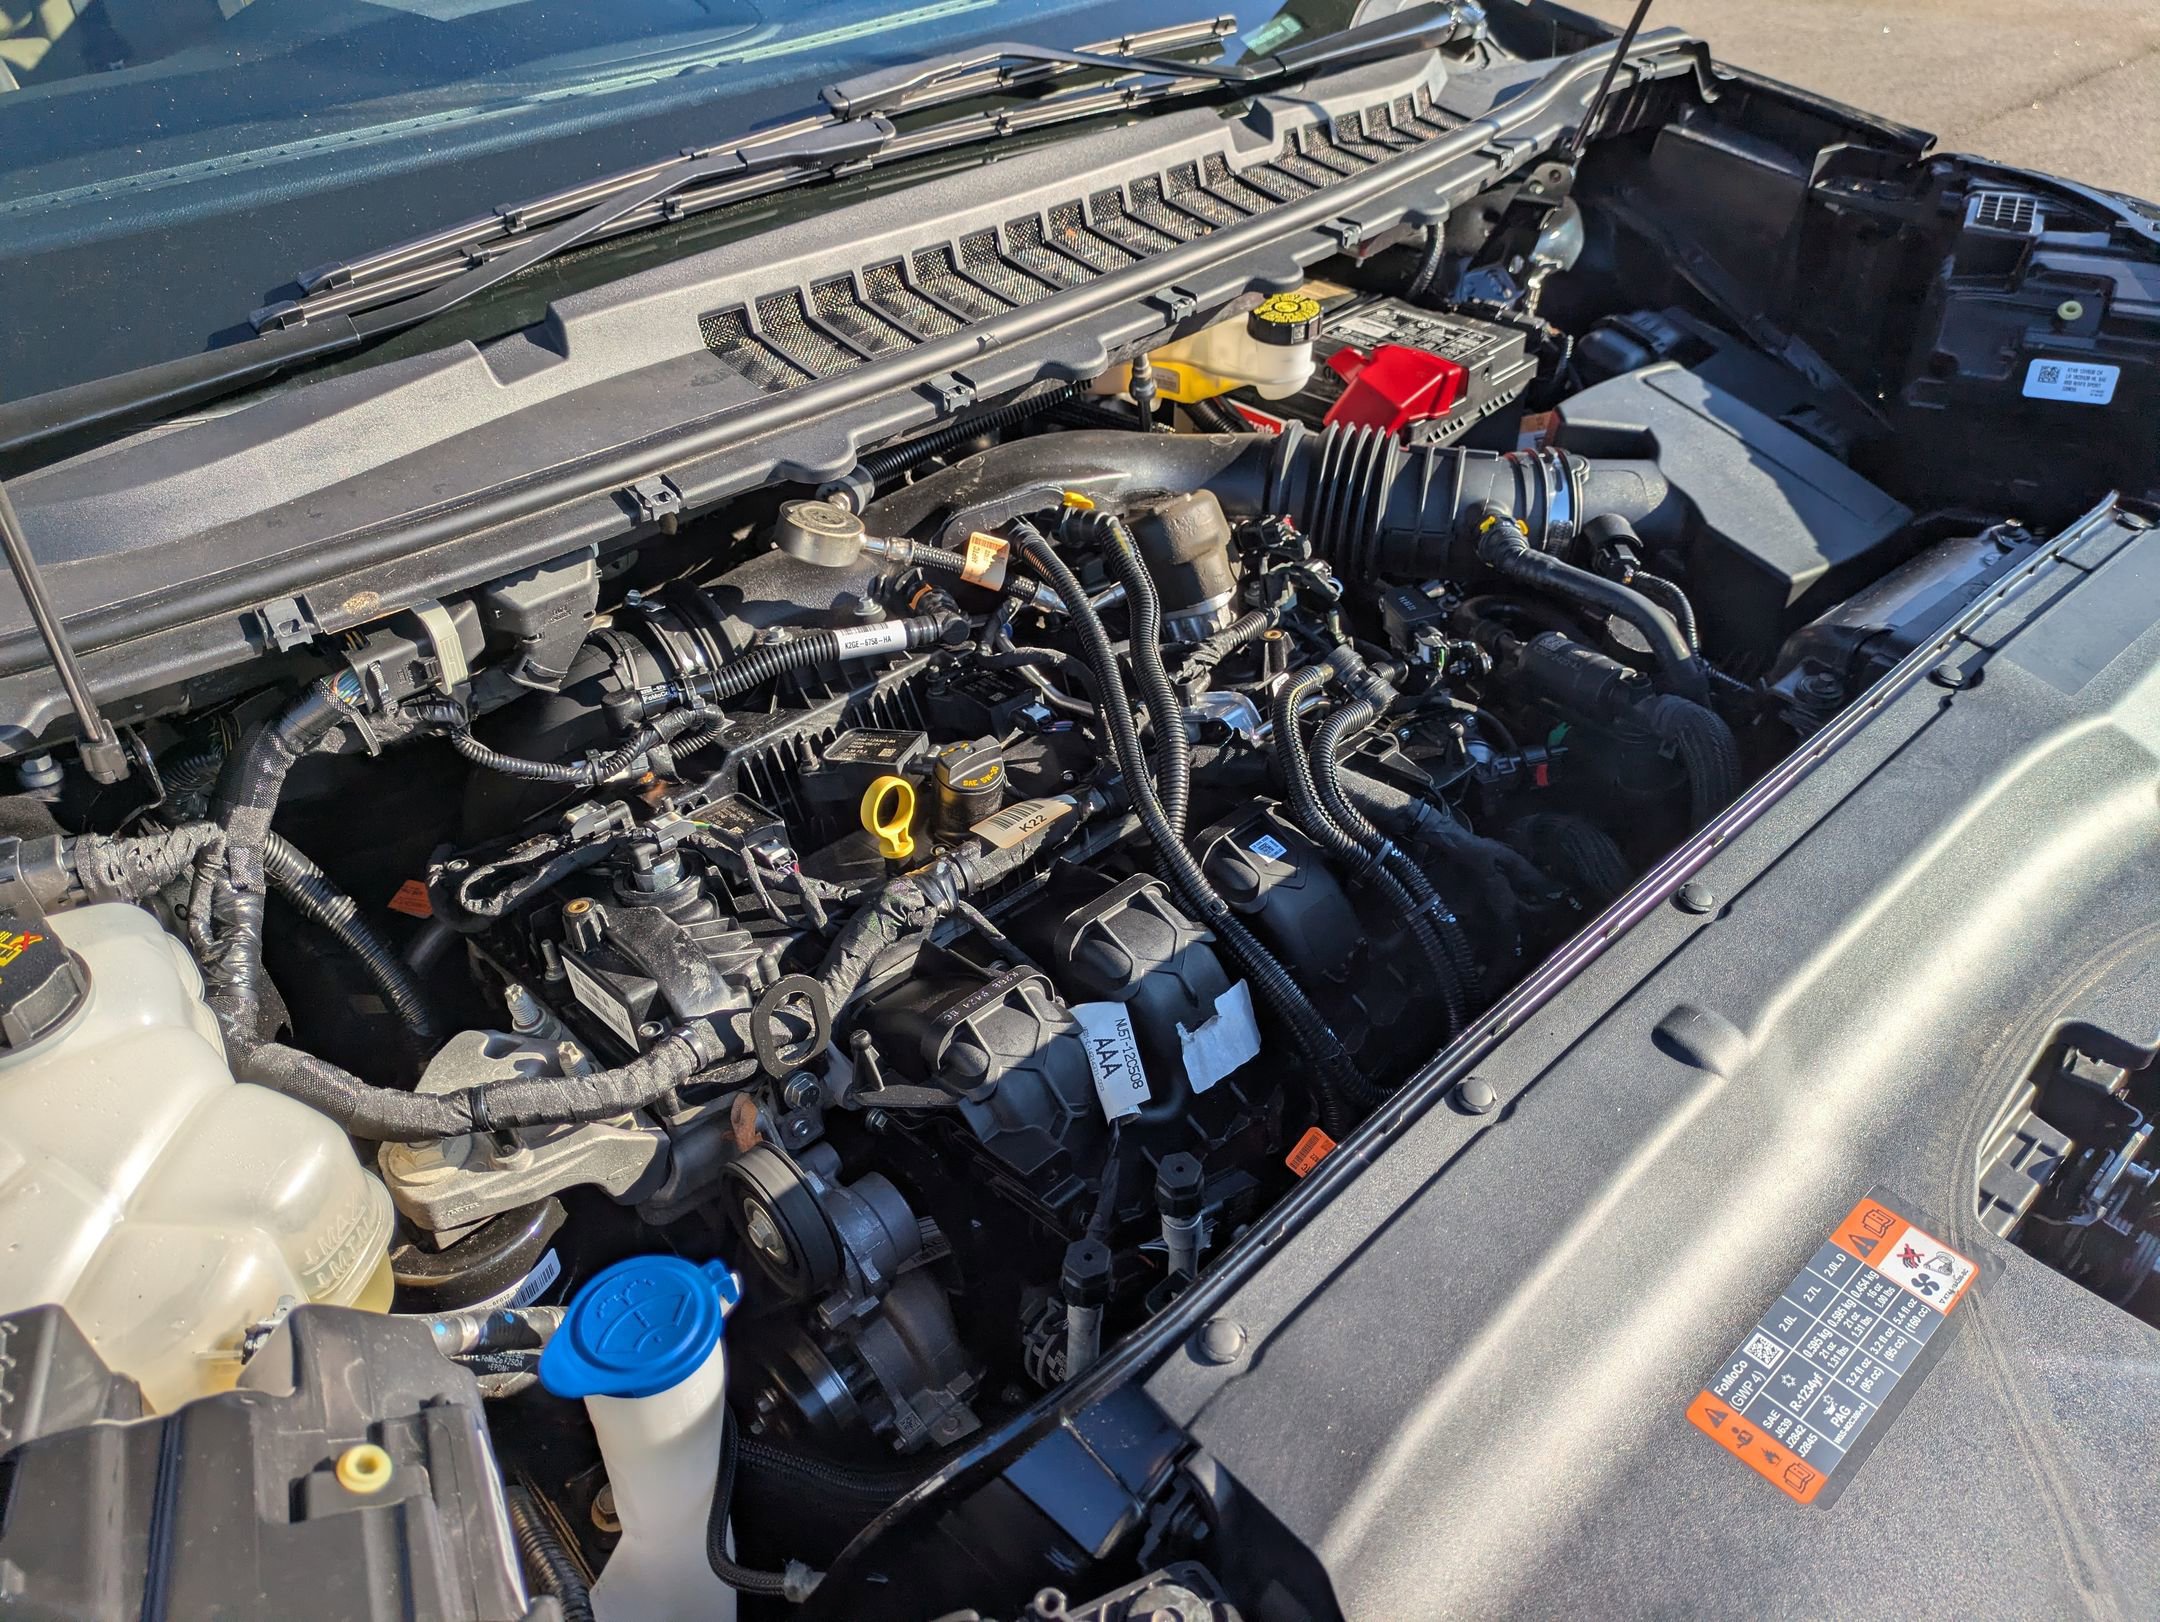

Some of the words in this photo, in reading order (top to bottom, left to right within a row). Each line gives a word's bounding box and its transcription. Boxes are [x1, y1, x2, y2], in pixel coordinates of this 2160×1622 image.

[1019, 814, 1048, 833] K22
[1092, 1038, 1123, 1080] AAA
[1115, 1018, 1145, 1090] NU5T-12C508
[1823, 1261, 1841, 1277] 2.0L
[1835, 1253, 1846, 1262] D
[1803, 1285, 1821, 1302] 2.7L
[1850, 1277, 1870, 1298] 0.454
[1863, 1270, 1879, 1281] kg
[1866, 1288, 1877, 1298] 16
[1873, 1282, 1883, 1291] oz
[1882, 1286, 1895, 1297] lbs
[1778, 1315, 1797, 1332] 2.0L
[1826, 1306, 1847, 1327] 0.595
[1840, 1298, 1856, 1310] kg
[1842, 1318, 1853, 1328] 21
[1850, 1311, 1860, 1321] oz
[1892, 1311, 1905, 1325] 5.4
[1900, 1305, 1910, 1314] fl
[1907, 1298, 1917, 1308] oz
[1904, 1315, 1921, 1333] (160
[1917, 1304, 1931, 1317] cc)
[1851, 1323, 1865, 1337] 1.31
[1859, 1315, 1872, 1326] lbs
[1802, 1336, 1823, 1358] 0.595
[1816, 1328, 1833, 1340] kg
[1818, 1348, 1830, 1359] 21
[1826, 1341, 1836, 1351] oz
[1869, 1340, 1883, 1354] 3.2
[1878, 1334, 1888, 1343] fl
[1884, 1326, 1895, 1337] oz
[1883, 1346, 1897, 1361] (95
[1893, 1335, 1908, 1349] cc)
[1826, 1353, 1841, 1368] 1.31
[1835, 1345, 1849, 1357] lbs
[1713, 1360, 1747, 1396] FoMoCo
[1845, 1371, 1860, 1386] 3.2
[1854, 1365, 1864, 1374] fl
[1861, 1357, 1872, 1368] oz
[1859, 1377, 1873, 1393] (95
[1870, 1366, 1884, 1380] cc)
[1728, 1380, 1753, 1411] (GWP
[1751, 1370, 1766, 1383] 4)
[1789, 1371, 1823, 1411] R-1234yf
[1762, 1409, 1780, 1428] SAE
[1774, 1417, 1792, 1438] J639
[1830, 1405, 1850, 1427] PAG
[1785, 1424, 1806, 1448] J2842
[1797, 1432, 1817, 1457] J2845
